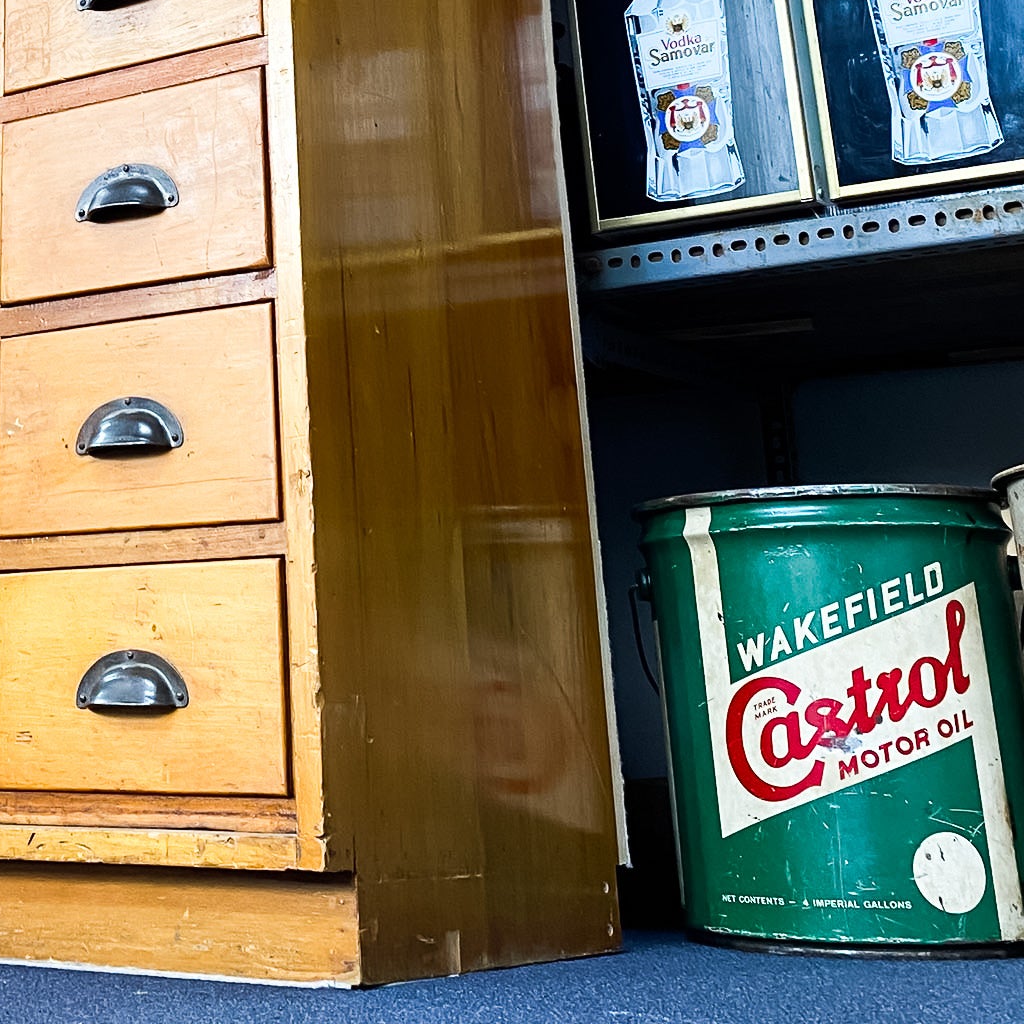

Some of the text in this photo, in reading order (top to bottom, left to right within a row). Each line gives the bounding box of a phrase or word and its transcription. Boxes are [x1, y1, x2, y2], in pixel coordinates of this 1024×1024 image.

[661, 34, 702, 50] Vodka
[649, 41, 715, 66] Samovar
[738, 561, 943, 672] WAKEFIELD
[726, 599, 971, 803] Castrol
[753, 696, 776, 711] TRADE
[754, 705, 778, 720] MARK
[838, 708, 974, 781] MOTOR OIL
[722, 894, 736, 903] NET
[738, 895, 785, 906] CONTENTS
[812, 899, 860, 909] IMPERIAL
[863, 900, 913, 910] GALLONS
